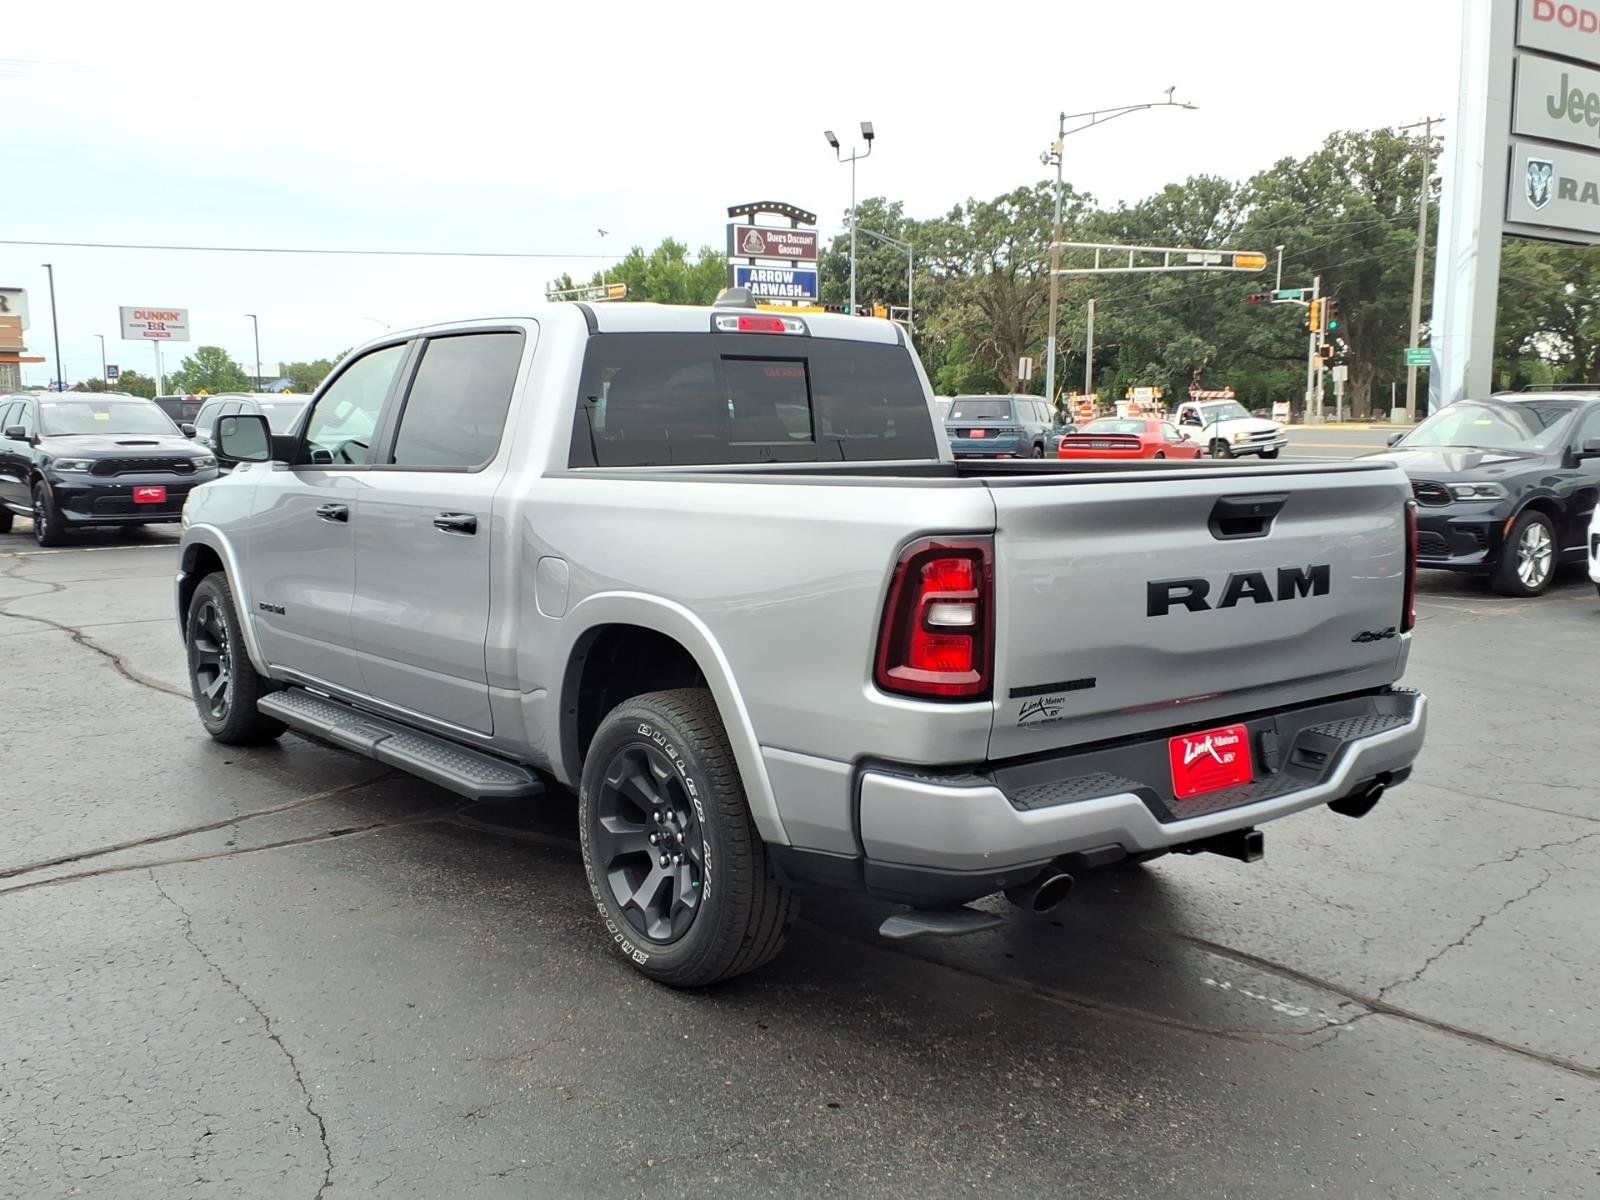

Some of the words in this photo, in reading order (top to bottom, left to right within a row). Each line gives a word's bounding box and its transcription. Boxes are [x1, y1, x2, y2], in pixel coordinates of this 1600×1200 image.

[1533, 0, 1600, 33] DOD
[1547, 73, 1600, 136] Jee
[750, 269, 793, 283] ARROW
[1147, 564, 1330, 617] RAM
[1183, 735, 1224, 765] Link
